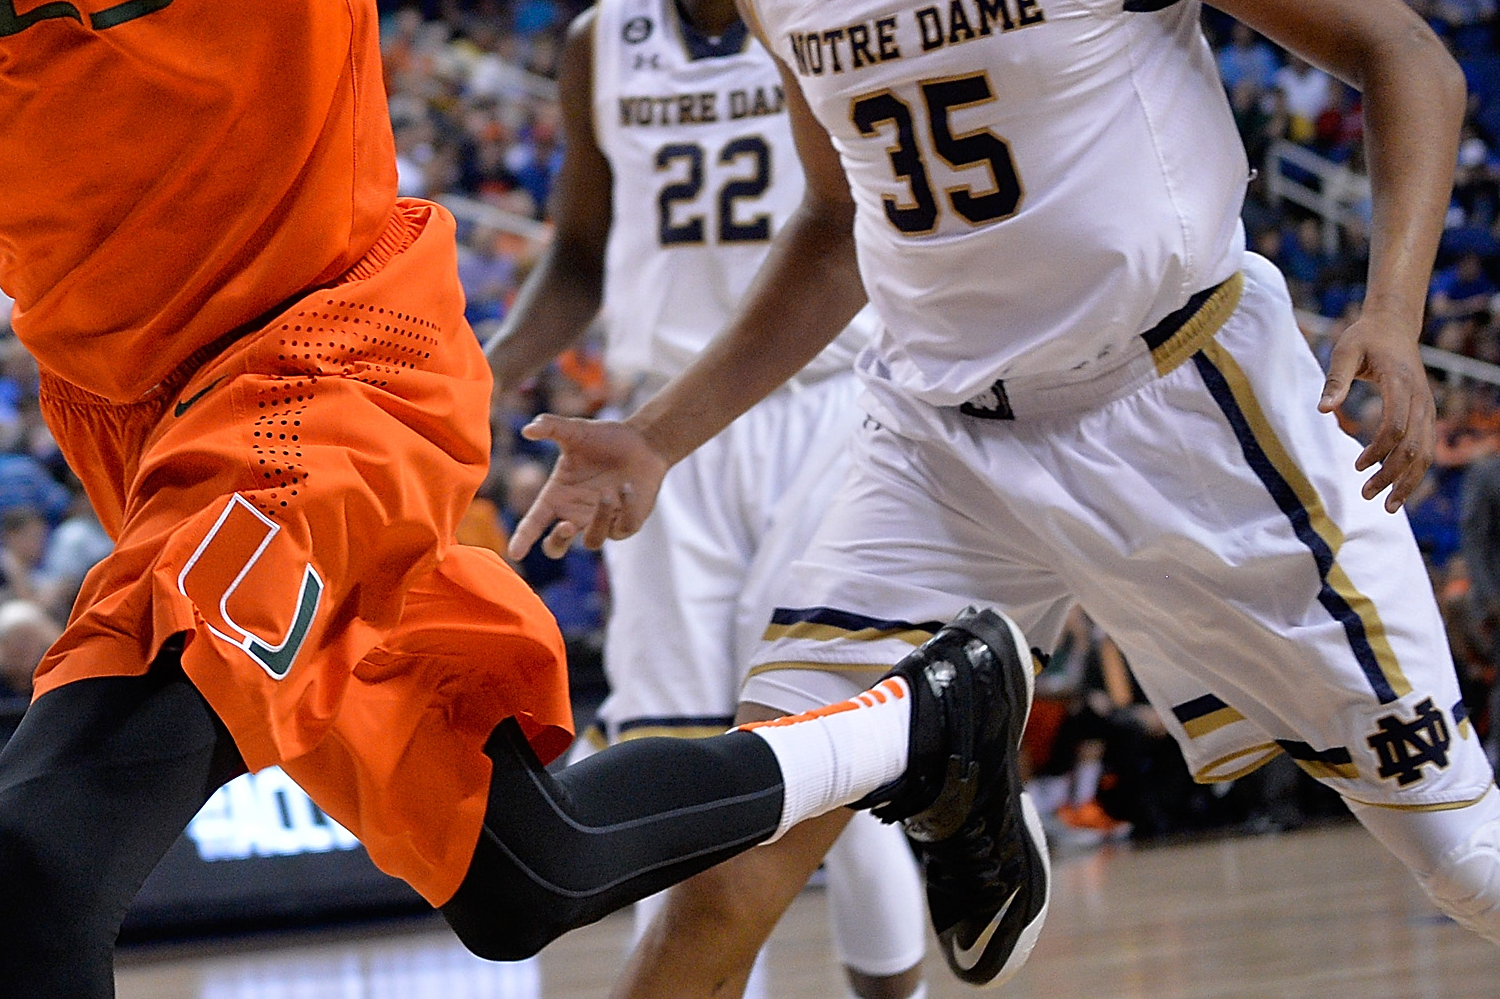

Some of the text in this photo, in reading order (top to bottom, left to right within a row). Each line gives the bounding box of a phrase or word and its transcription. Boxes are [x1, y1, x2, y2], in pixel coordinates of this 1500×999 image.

[789, 14, 903, 77] NOTRE
[618, 90, 718, 128] NOTRE
[655, 137, 771, 248] 22
[847, 69, 1026, 237] 35
